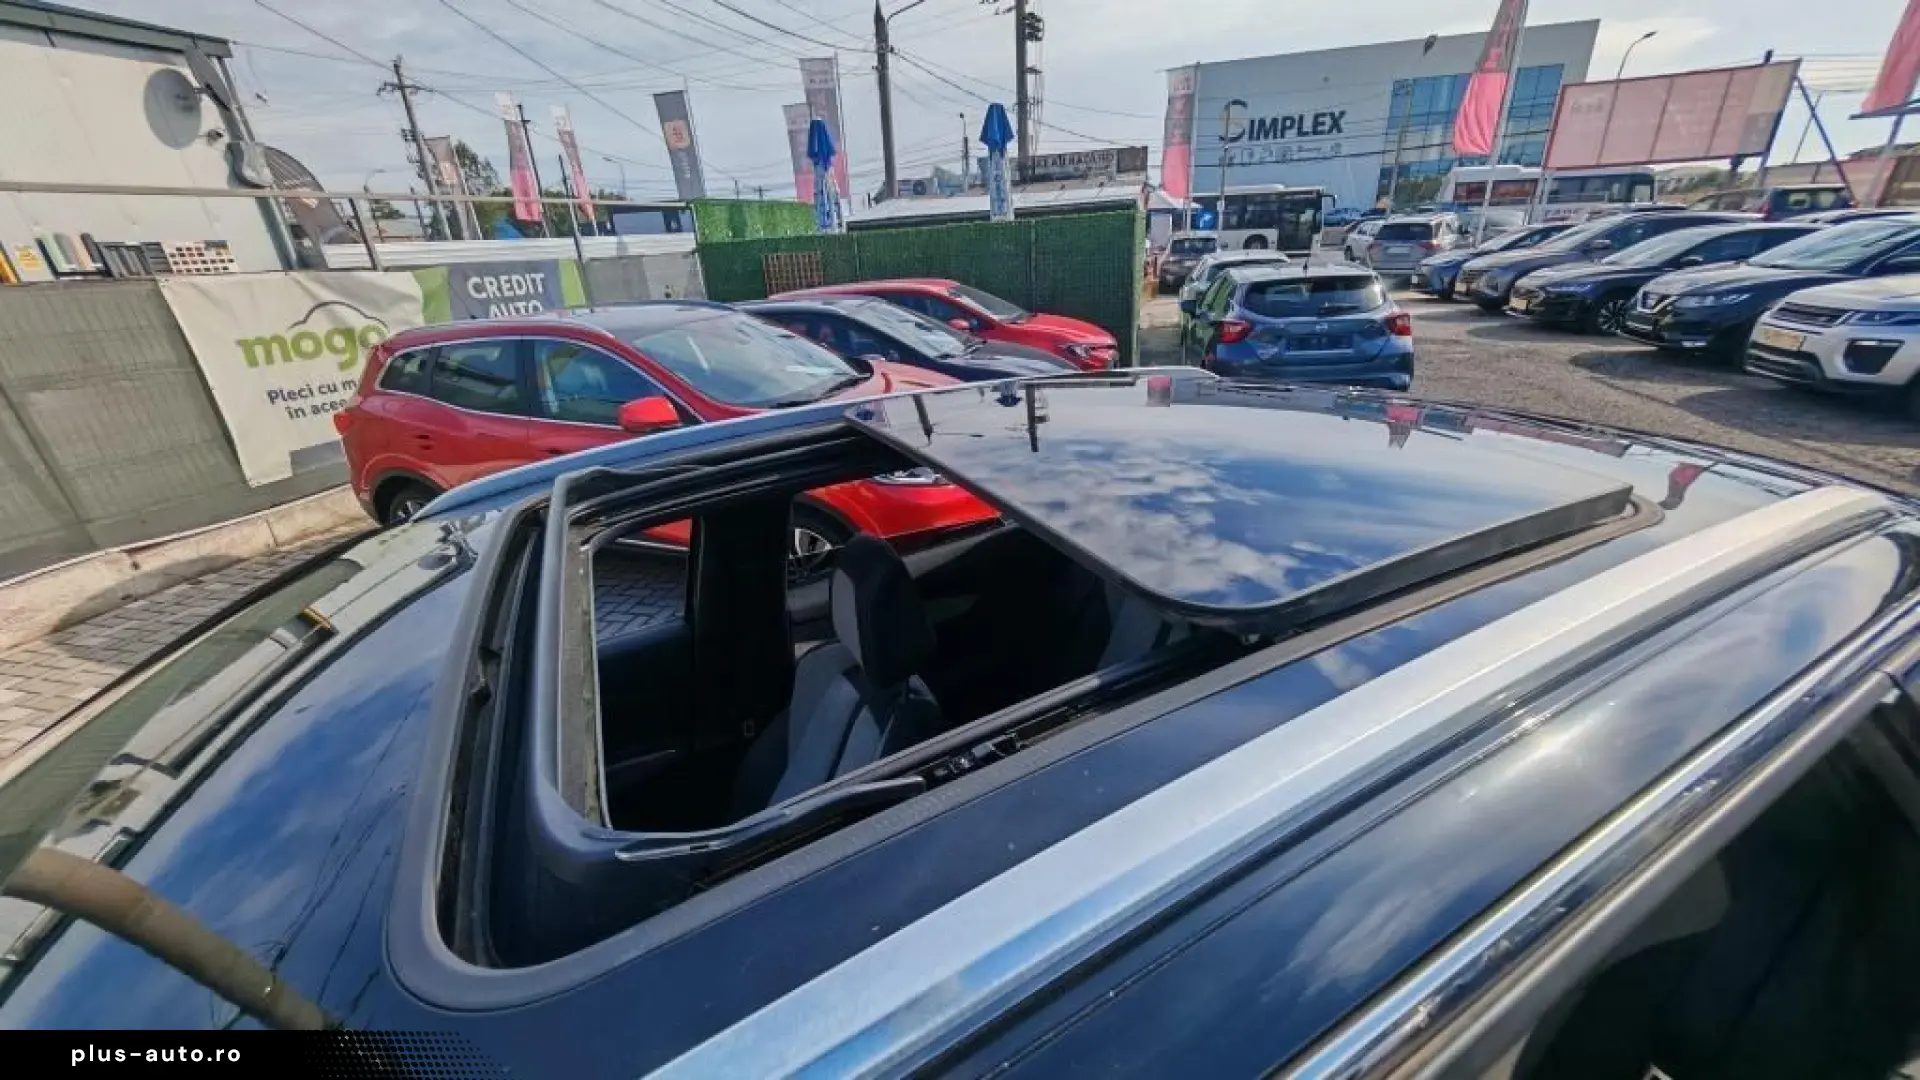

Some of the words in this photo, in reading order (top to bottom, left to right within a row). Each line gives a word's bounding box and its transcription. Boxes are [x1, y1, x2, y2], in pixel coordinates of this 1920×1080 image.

[1218, 98, 1347, 142] SIMPLEX
[467, 272, 545, 299] CREDIT
[489, 299, 543, 317] AUTO
[236, 324, 387, 372] mogo
[267, 383, 314, 405] Pleci
[318, 382, 338, 395] cu
